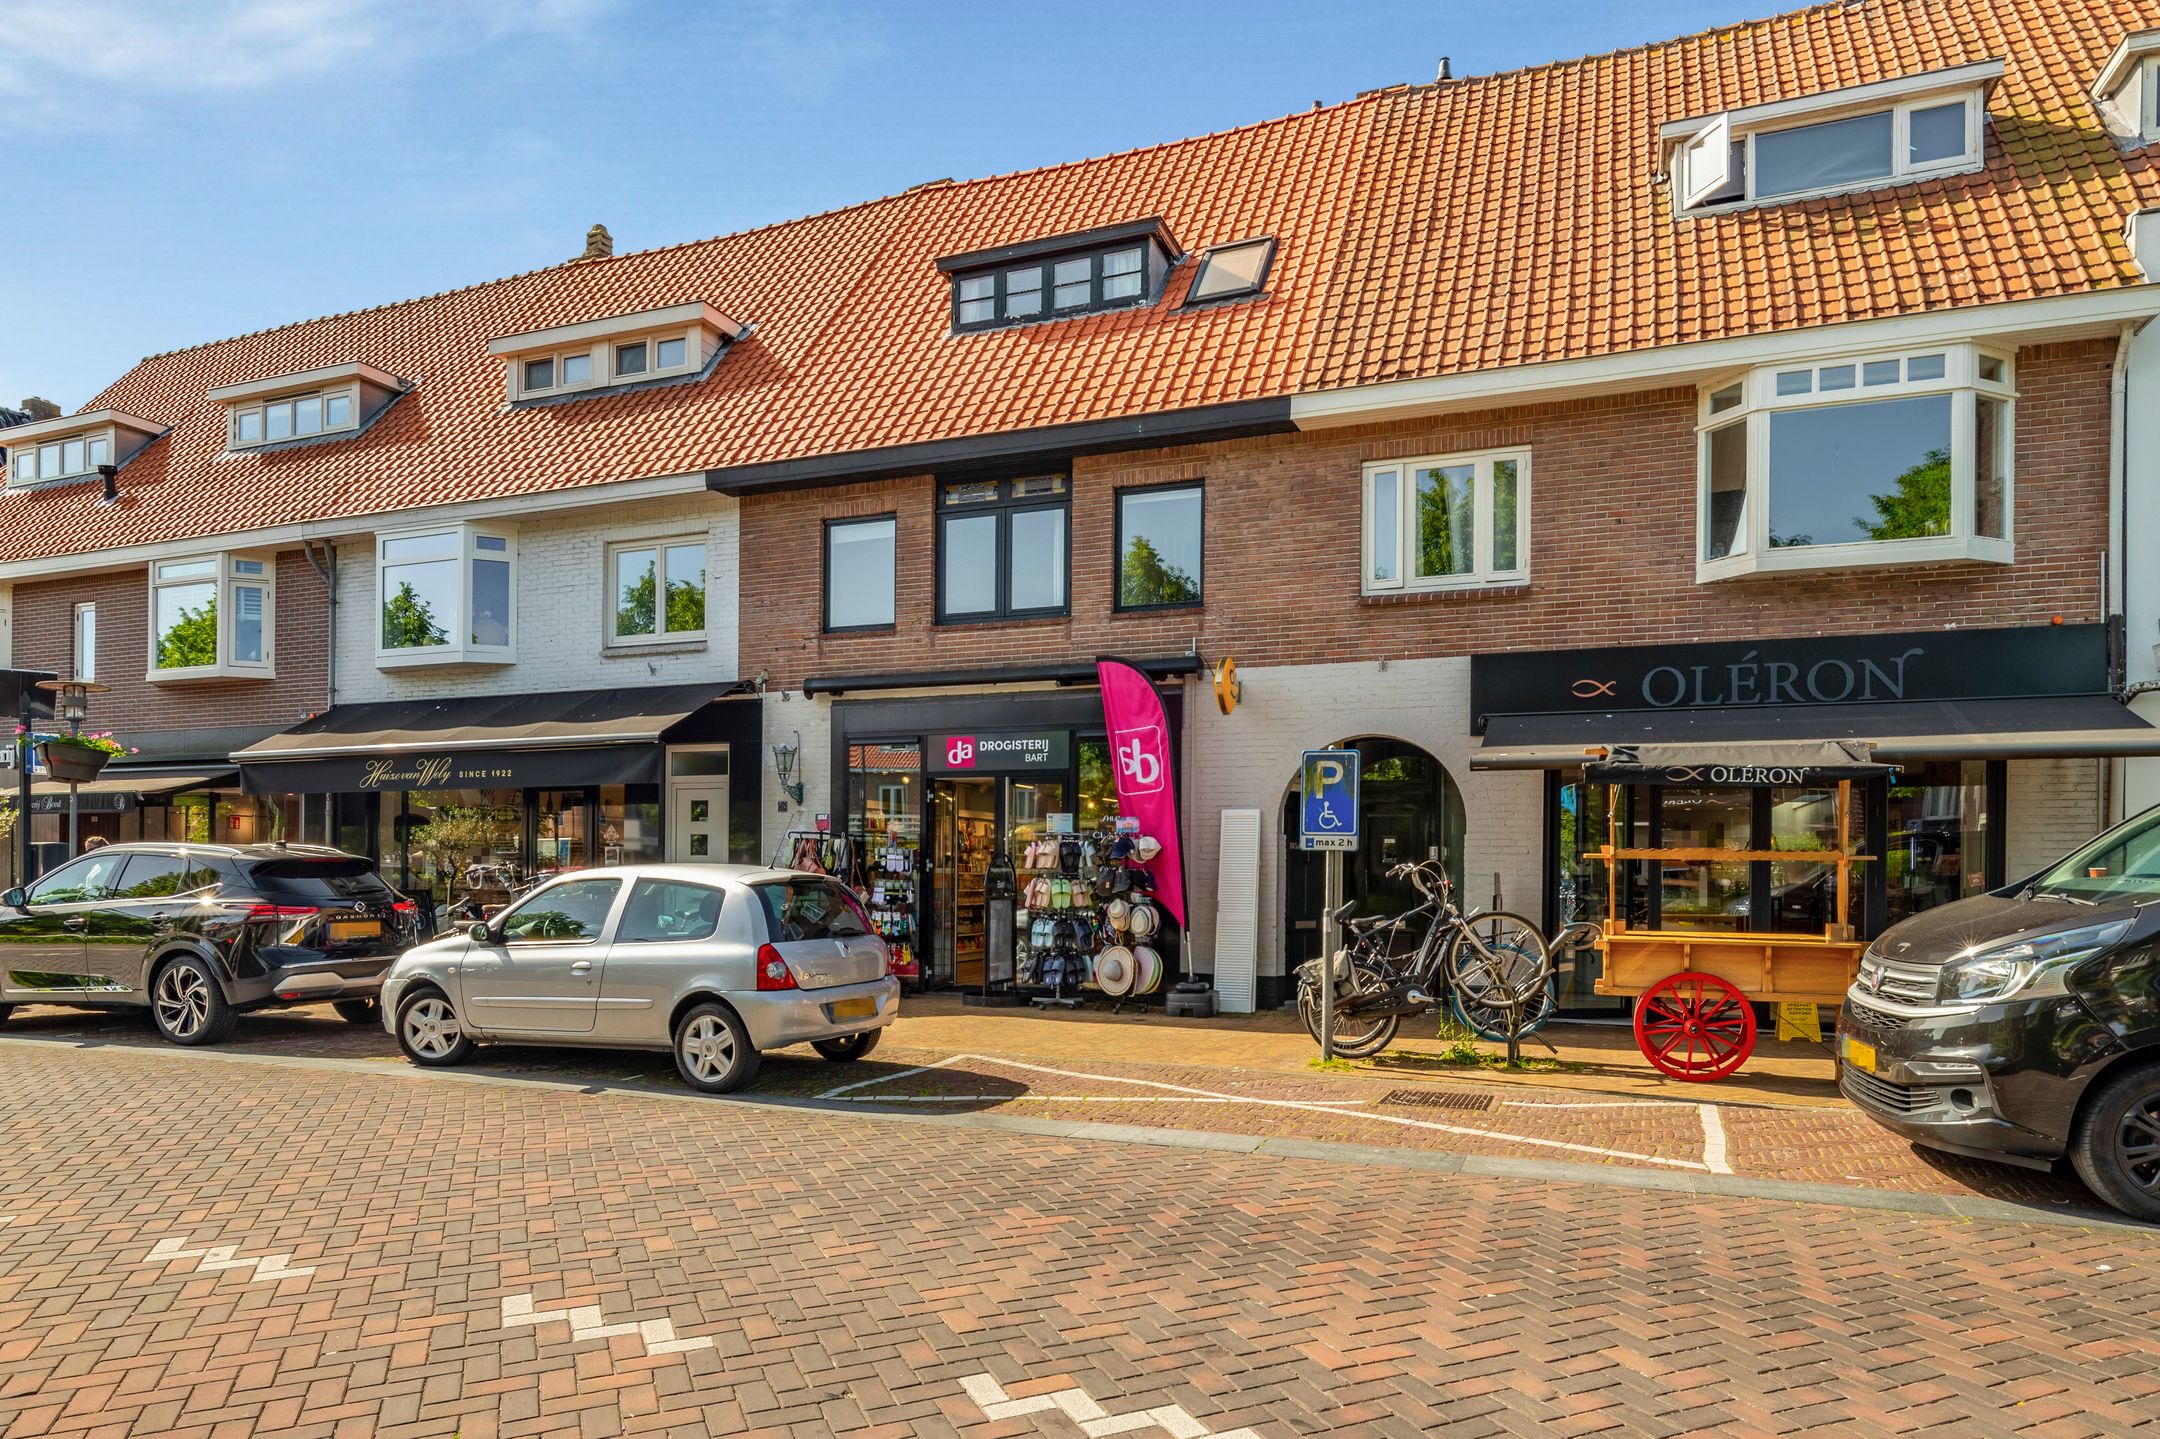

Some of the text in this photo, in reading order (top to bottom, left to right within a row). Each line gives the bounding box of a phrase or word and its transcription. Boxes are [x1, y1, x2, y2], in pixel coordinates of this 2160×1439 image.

[1641, 648, 1924, 707] OLÉRON
[948, 739, 1049, 764] da DROGISTERIJ
[1025, 753, 1048, 762] BART
[359, 757, 452, 788] Huize van Wely
[459, 769, 512, 778] SINCE 1922
[1315, 760, 1344, 799] P
[1710, 765, 1810, 784] OLÉRON
[1338, 839, 1345, 847] 2
[1347, 838, 1353, 847] h
